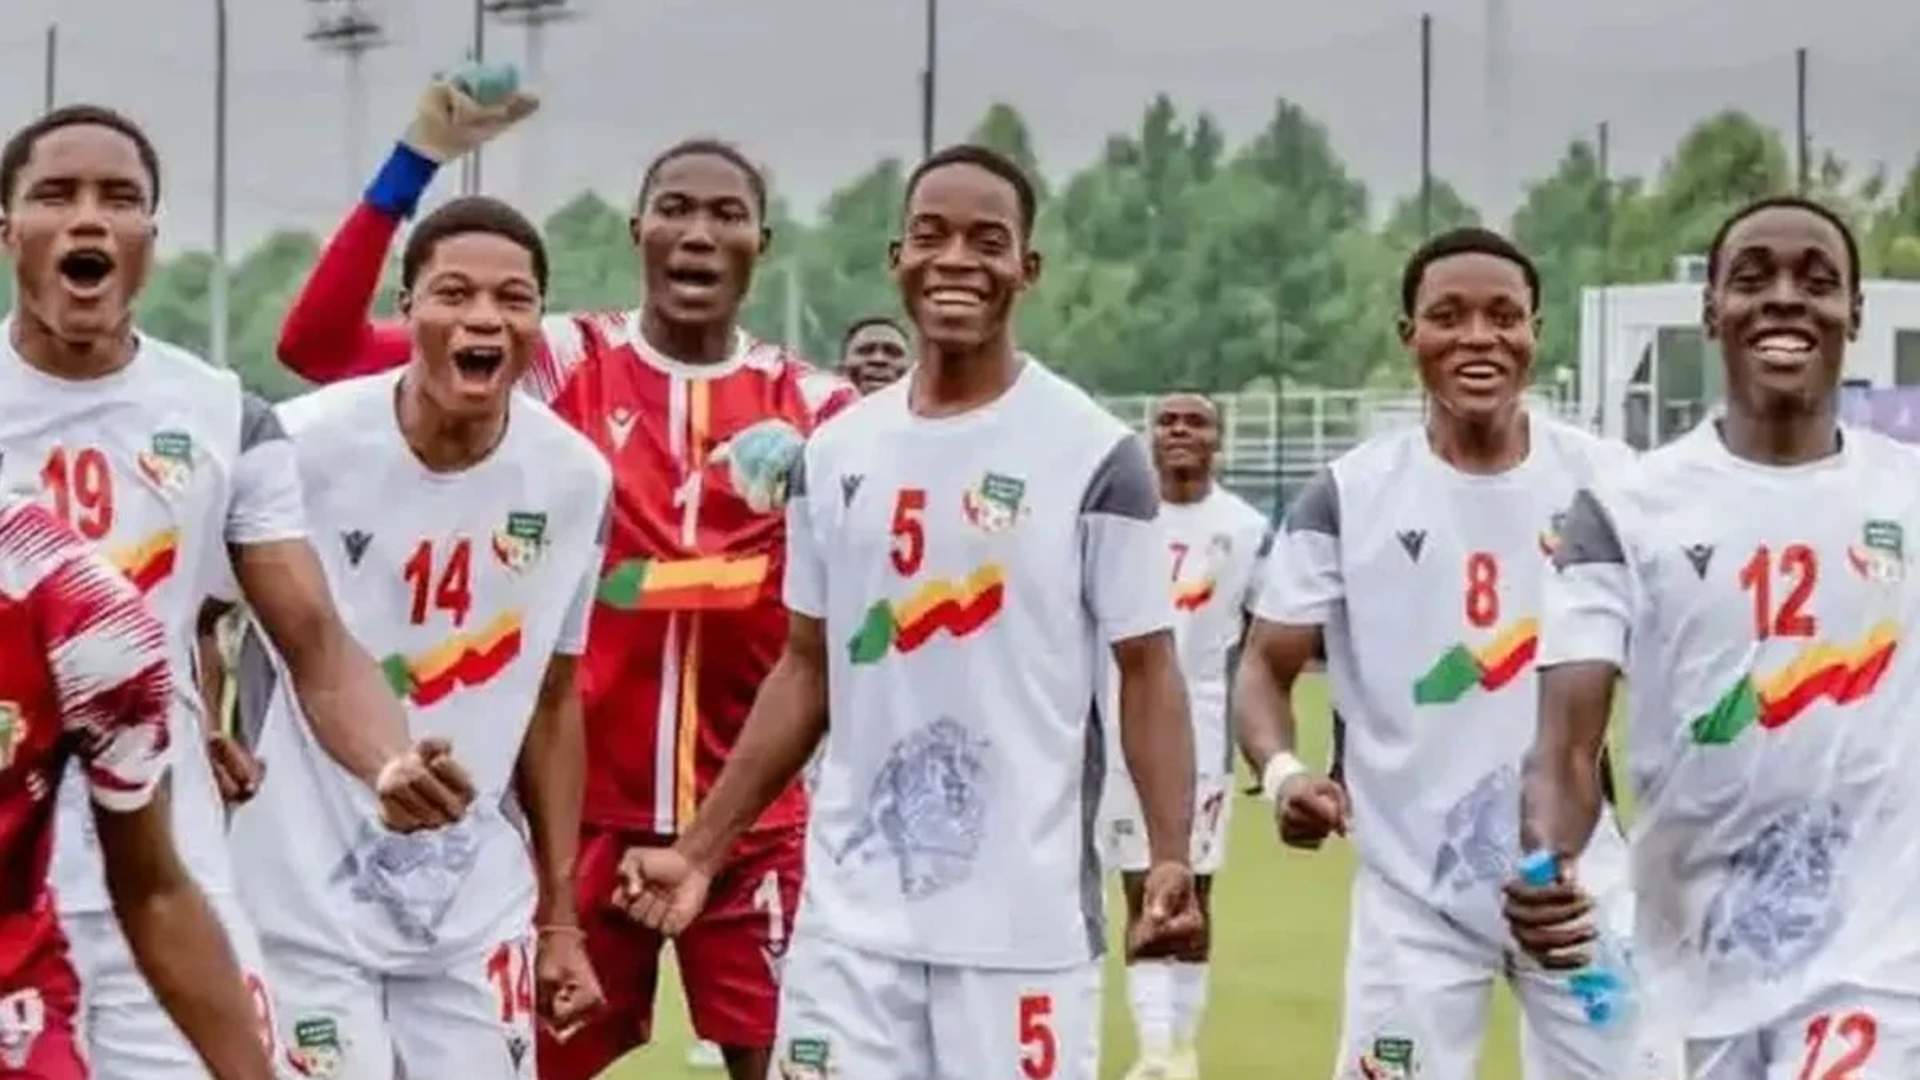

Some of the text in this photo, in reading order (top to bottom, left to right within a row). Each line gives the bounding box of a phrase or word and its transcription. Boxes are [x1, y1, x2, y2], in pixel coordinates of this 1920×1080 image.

[41, 446, 116, 540] 19
[673, 472, 702, 548] 1
[890, 489, 927, 577] 5
[404, 539, 471, 626] 14
[1465, 552, 1499, 627] 8
[1740, 544, 1816, 640] 12
[752, 869, 784, 941] 1
[1018, 995, 1058, 1080] 5
[1798, 1012, 1878, 1080] 12
